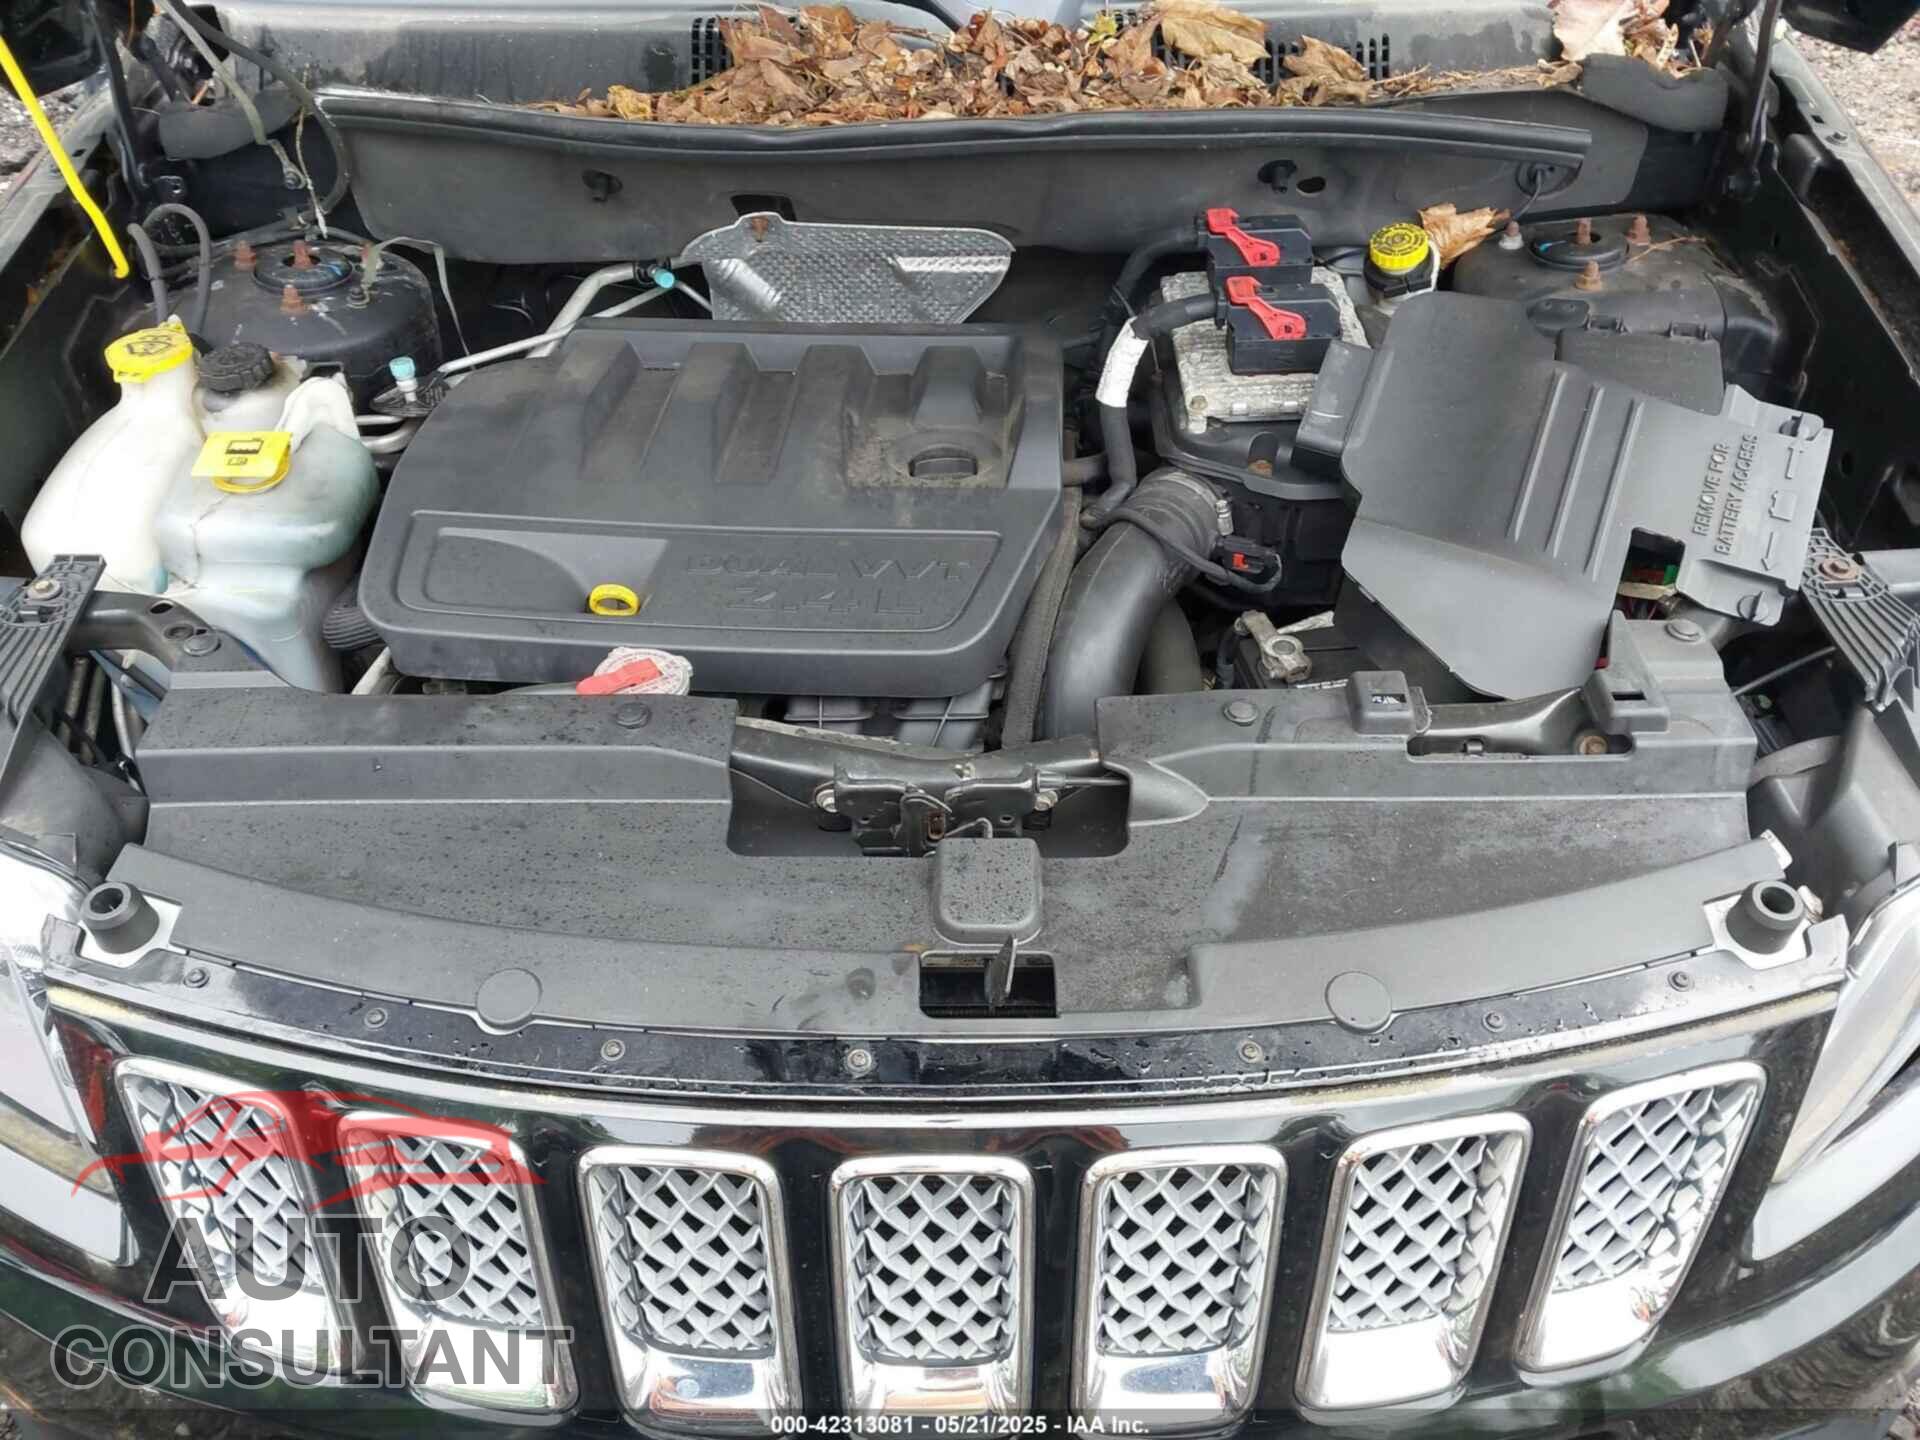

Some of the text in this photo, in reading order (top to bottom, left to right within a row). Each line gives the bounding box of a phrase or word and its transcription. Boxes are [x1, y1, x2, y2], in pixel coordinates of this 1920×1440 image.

[1692, 441, 1729, 536] REMOVE FOR
[1714, 433, 1758, 556] BATTERY ACCESS
